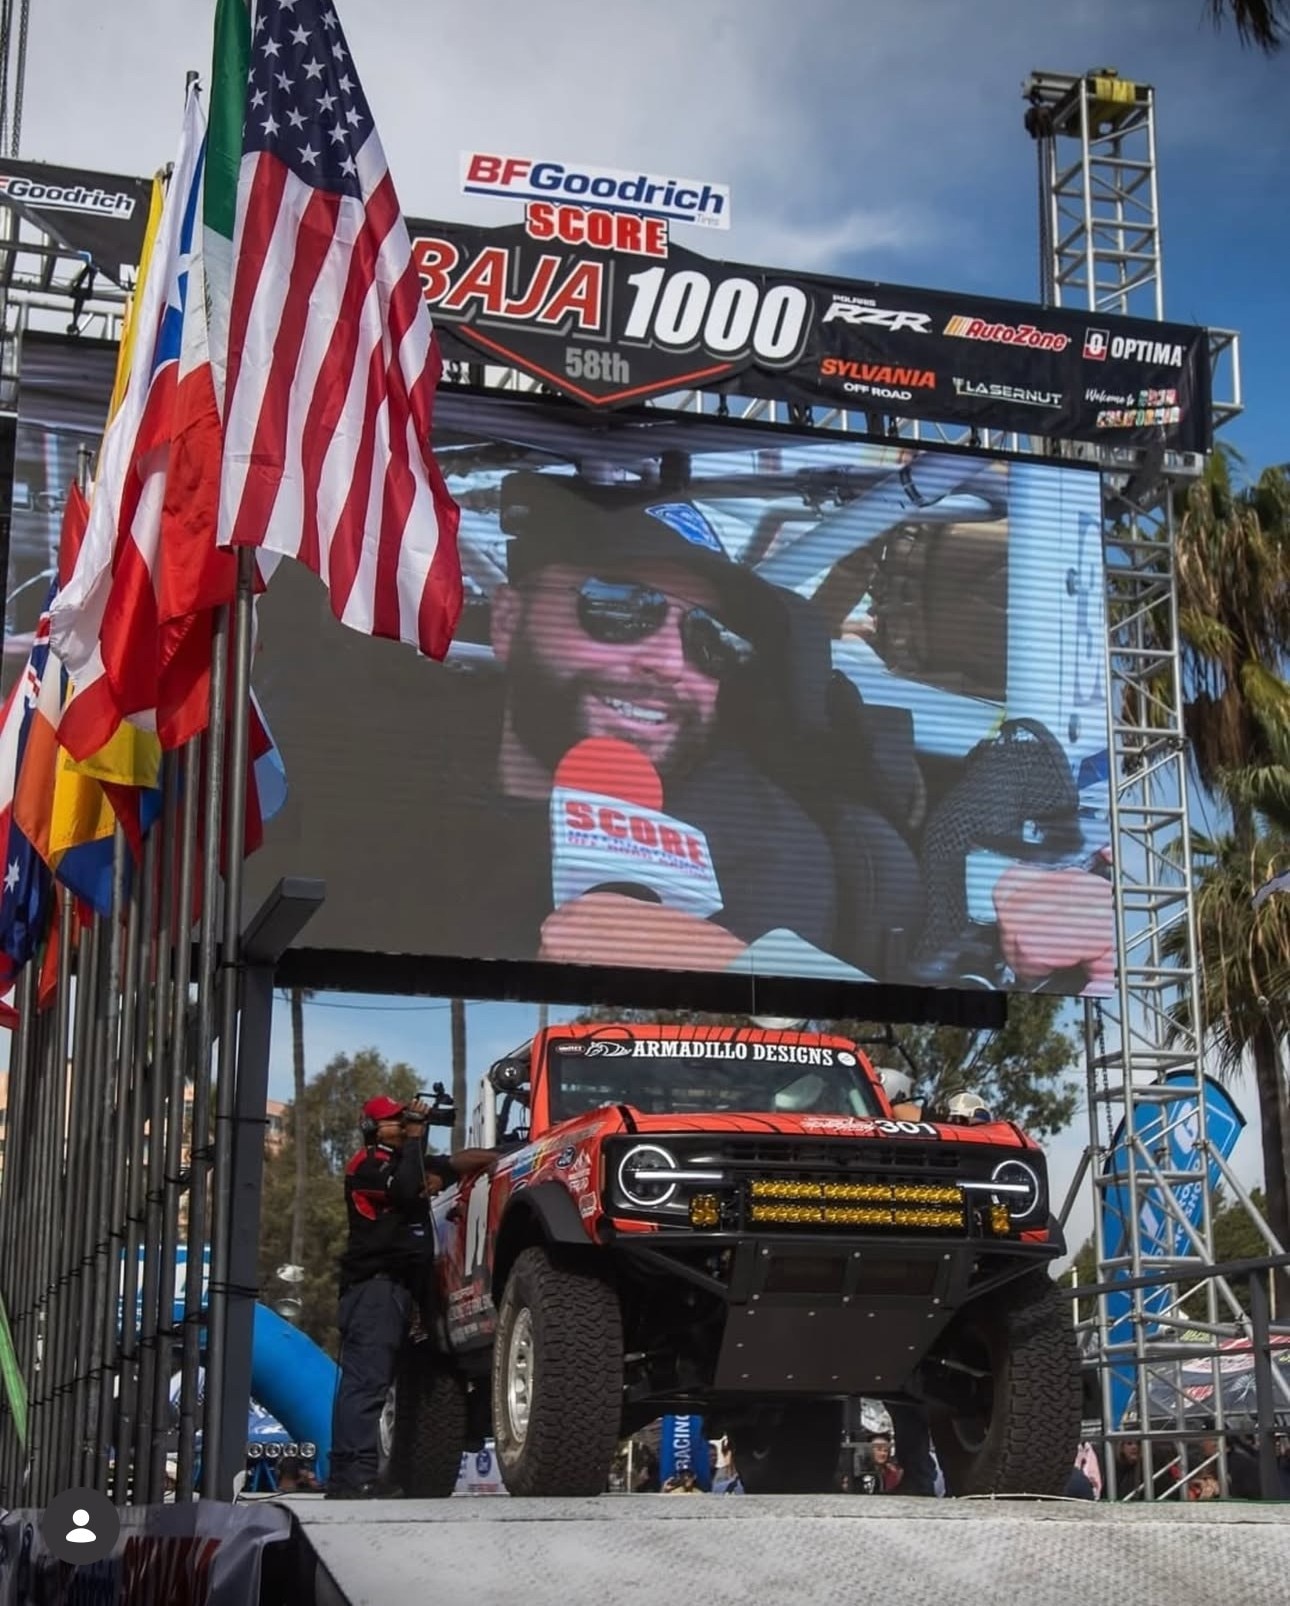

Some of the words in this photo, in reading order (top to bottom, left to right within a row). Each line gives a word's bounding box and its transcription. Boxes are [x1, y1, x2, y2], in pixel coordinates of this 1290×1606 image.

[466, 154, 725, 213] BFGoodrich
[527, 203, 668, 257] SCORE
[412, 236, 604, 330] BAJA
[624, 266, 807, 359] 1000
[832, 294, 876, 307] POLARIS
[822, 302, 932, 333] RZR
[966, 318, 1068, 352] AutoZone
[565, 347, 629, 384] 58th
[1111, 336, 1183, 367] OPTIMA
[821, 358, 936, 389] SYLVANIA
[843, 382, 869, 393] OFF
[871, 386, 912, 400] ROAD
[966, 380, 1062, 405] LASERNUT
[1085, 388, 1125, 403] Welcome
[1126, 394, 1135, 406] to
[565, 801, 707, 867] SCORE
[632, 1040, 747, 1060] ARMADILLO
[753, 1043, 834, 1066] DESIGNS
[876, 1119, 937, 1135] 301
